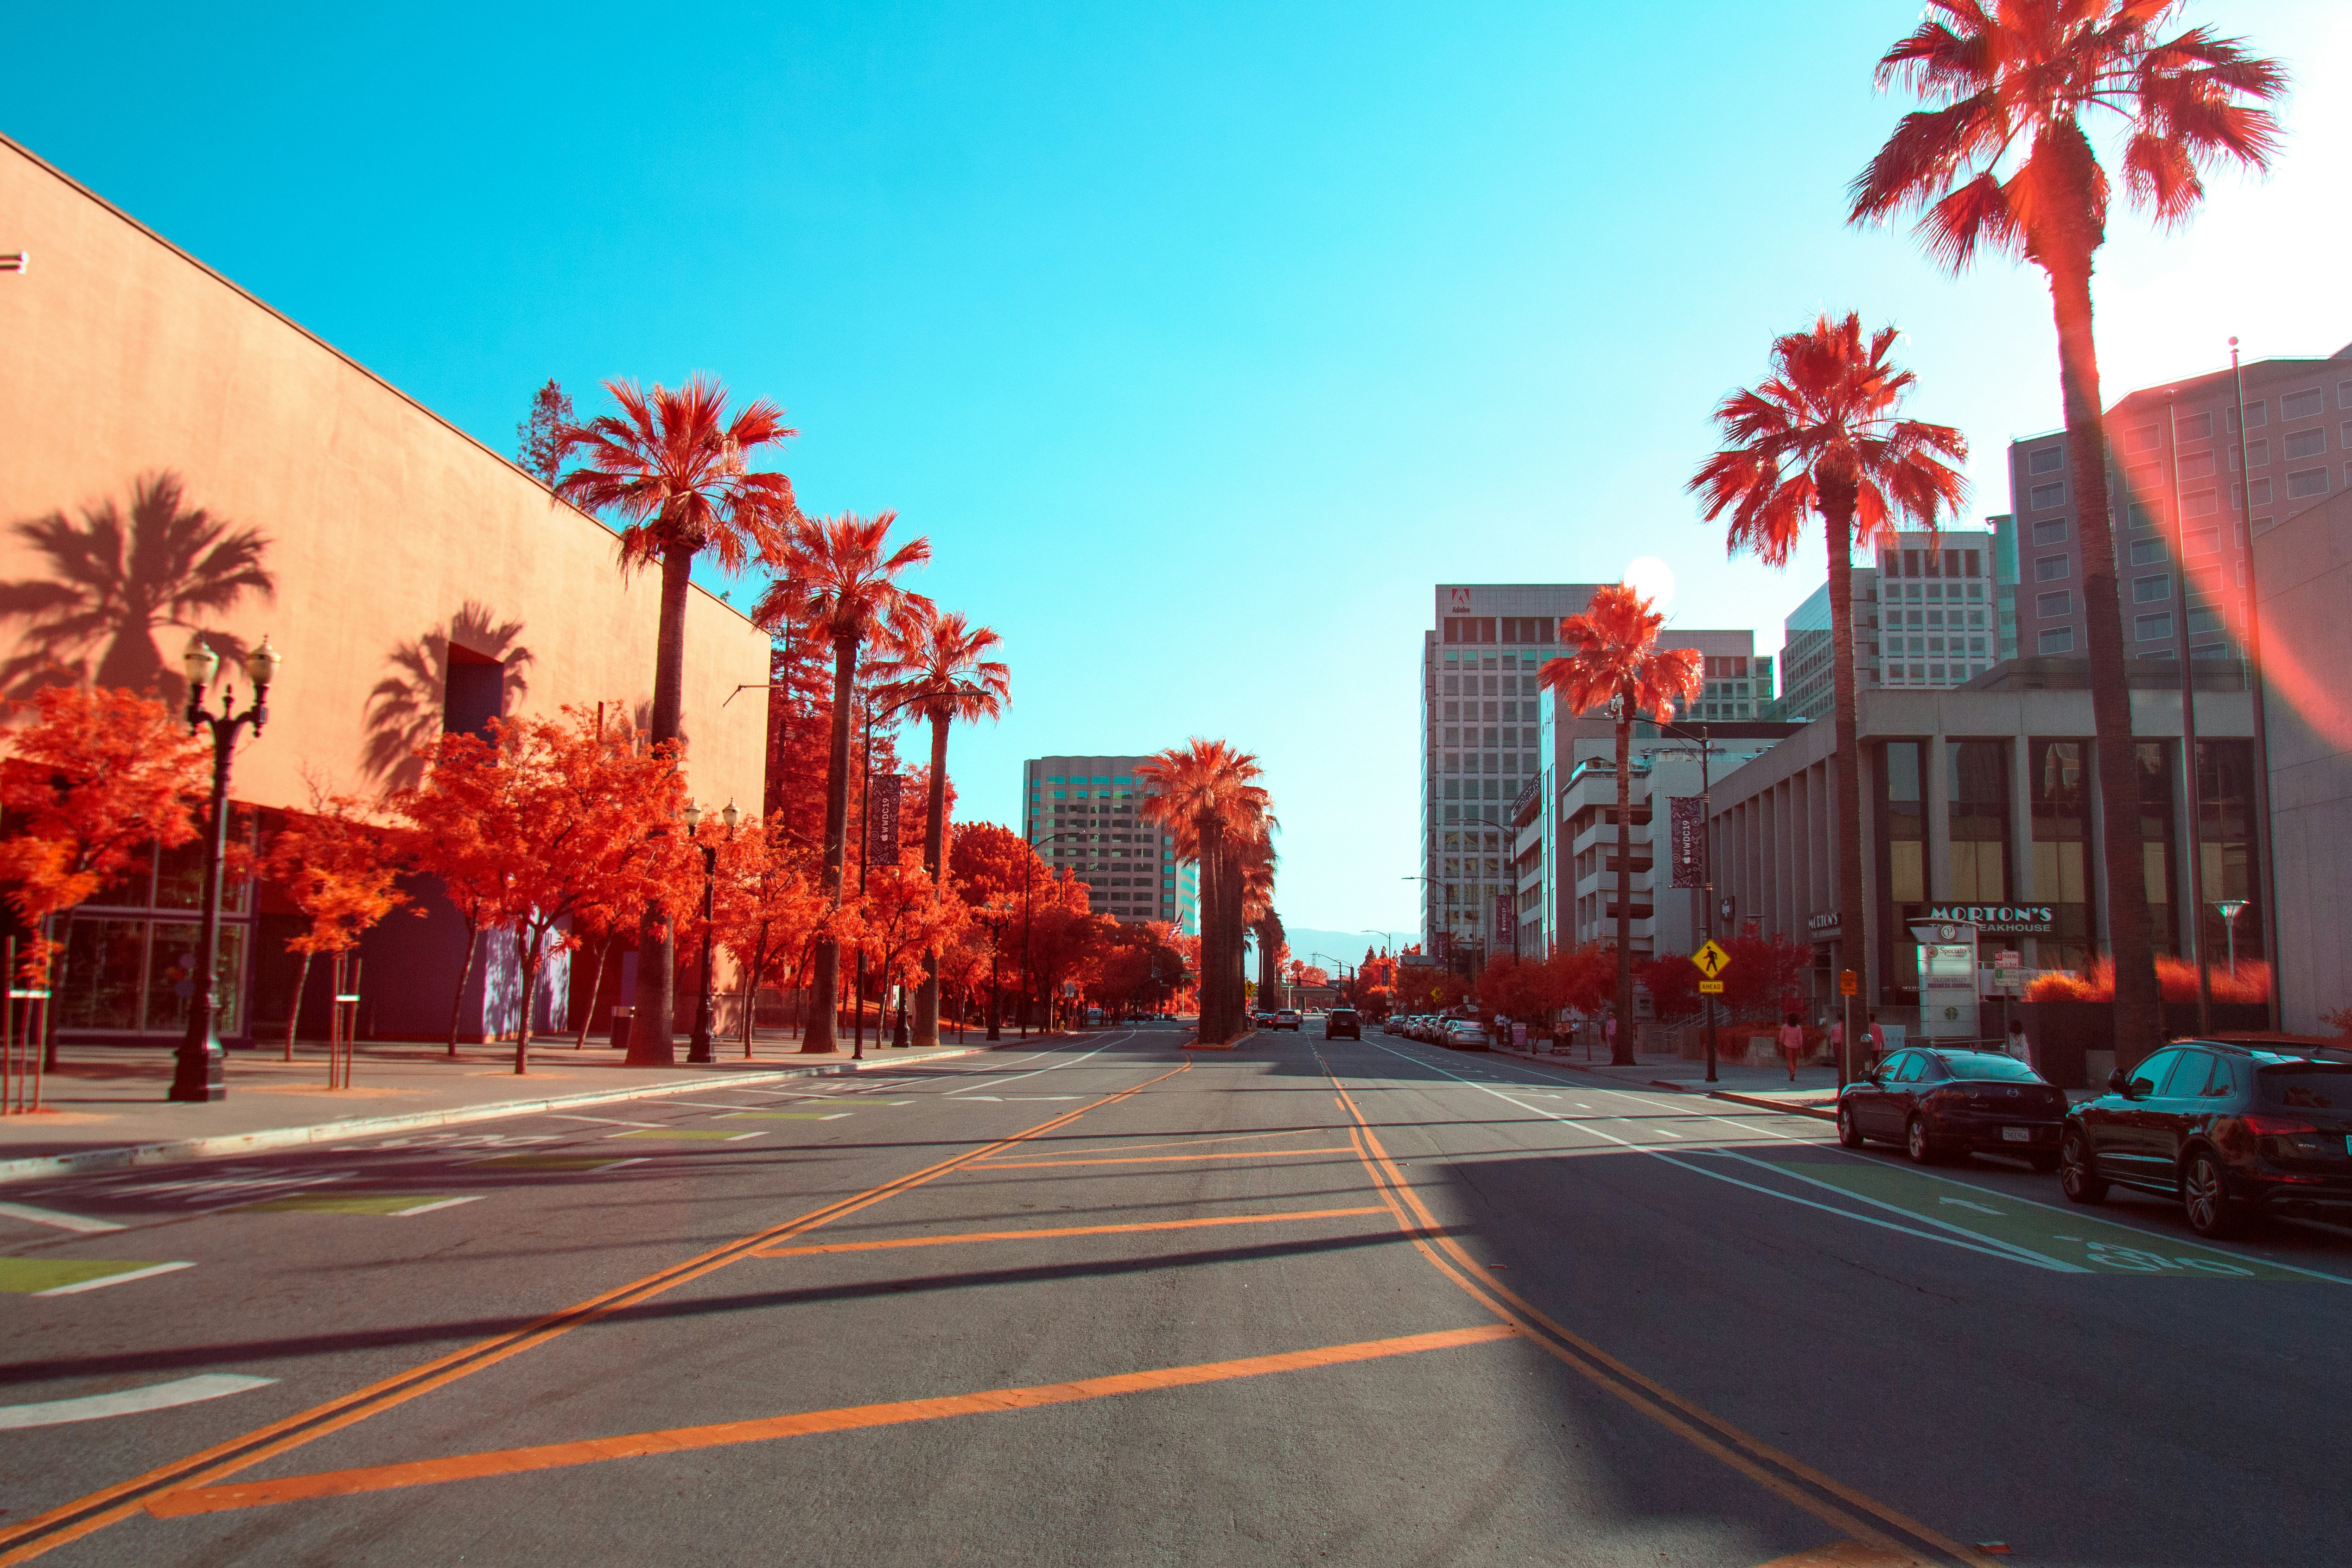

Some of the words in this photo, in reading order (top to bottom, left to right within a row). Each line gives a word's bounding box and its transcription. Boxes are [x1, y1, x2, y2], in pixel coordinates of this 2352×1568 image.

[1683, 820, 1691, 855] WWDC19
[1808, 912, 1838, 929] MORTON'S
[1930, 907, 2053, 921] MORTON'S
[1940, 947, 1972, 956] Specialty's
